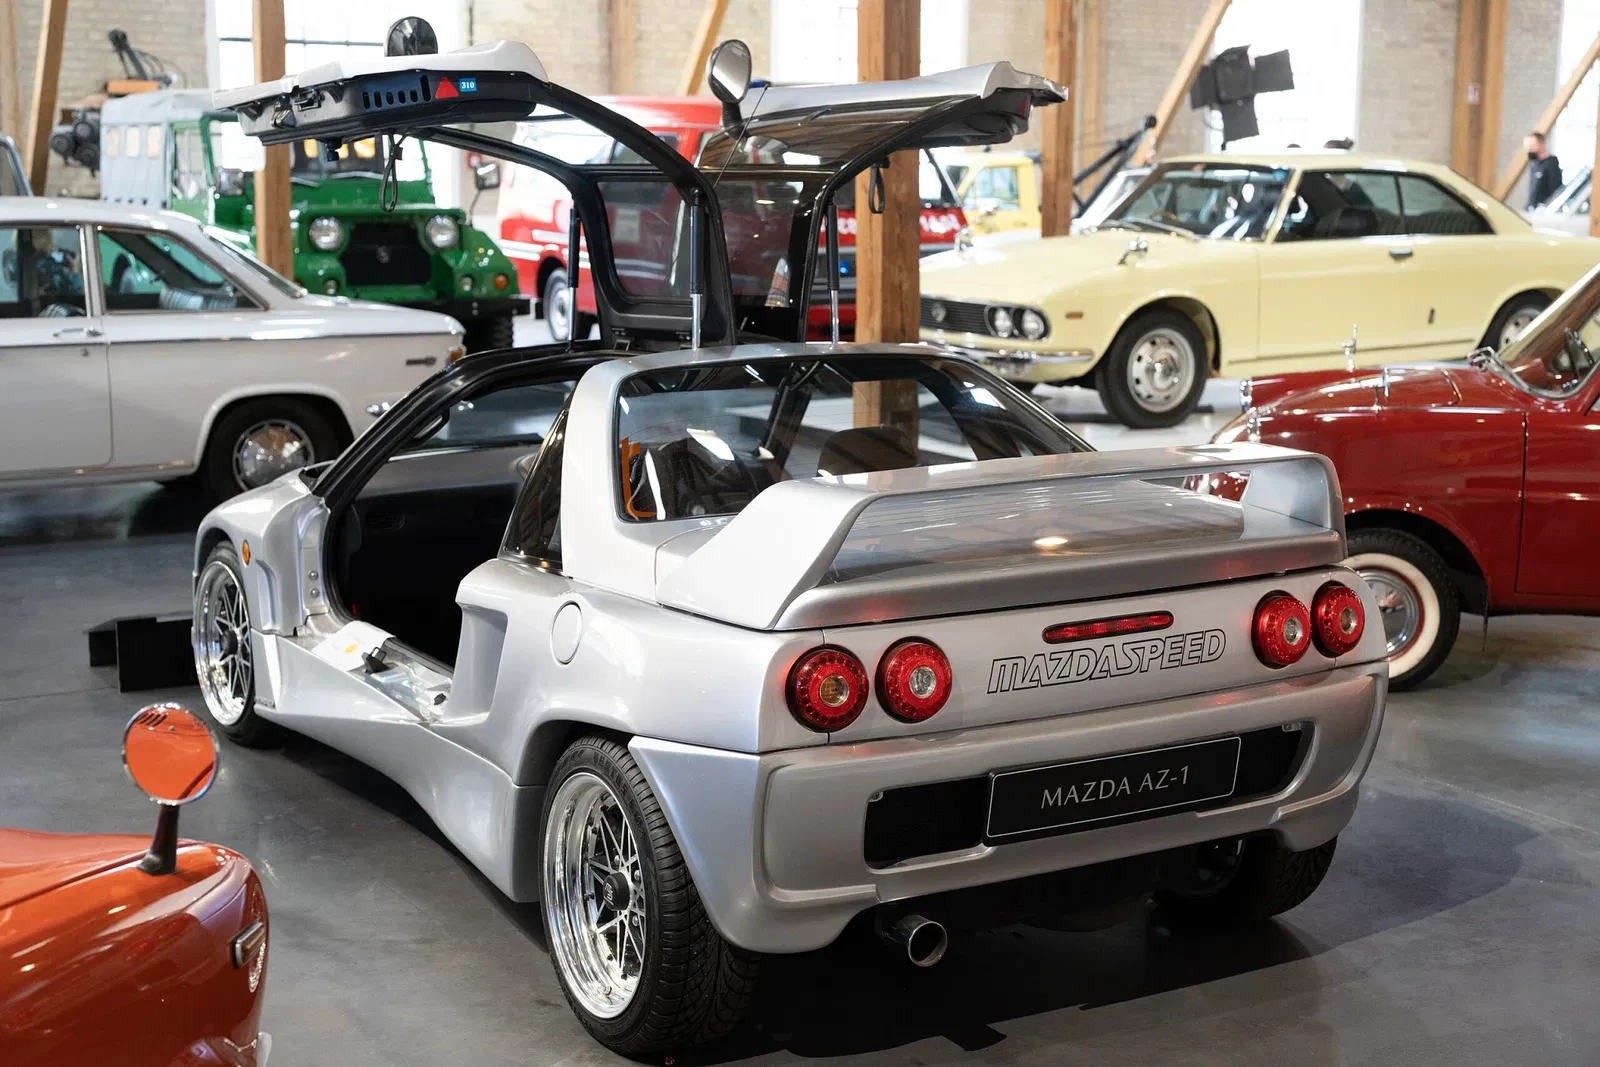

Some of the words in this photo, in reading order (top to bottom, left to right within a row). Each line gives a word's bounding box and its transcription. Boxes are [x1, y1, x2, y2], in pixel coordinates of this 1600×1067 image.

[461, 81, 475, 89] 310
[986, 628, 1227, 694] MAZDASPEED
[1041, 776, 1131, 809] MAZDA
[1138, 765, 1189, 793] AZ-1
